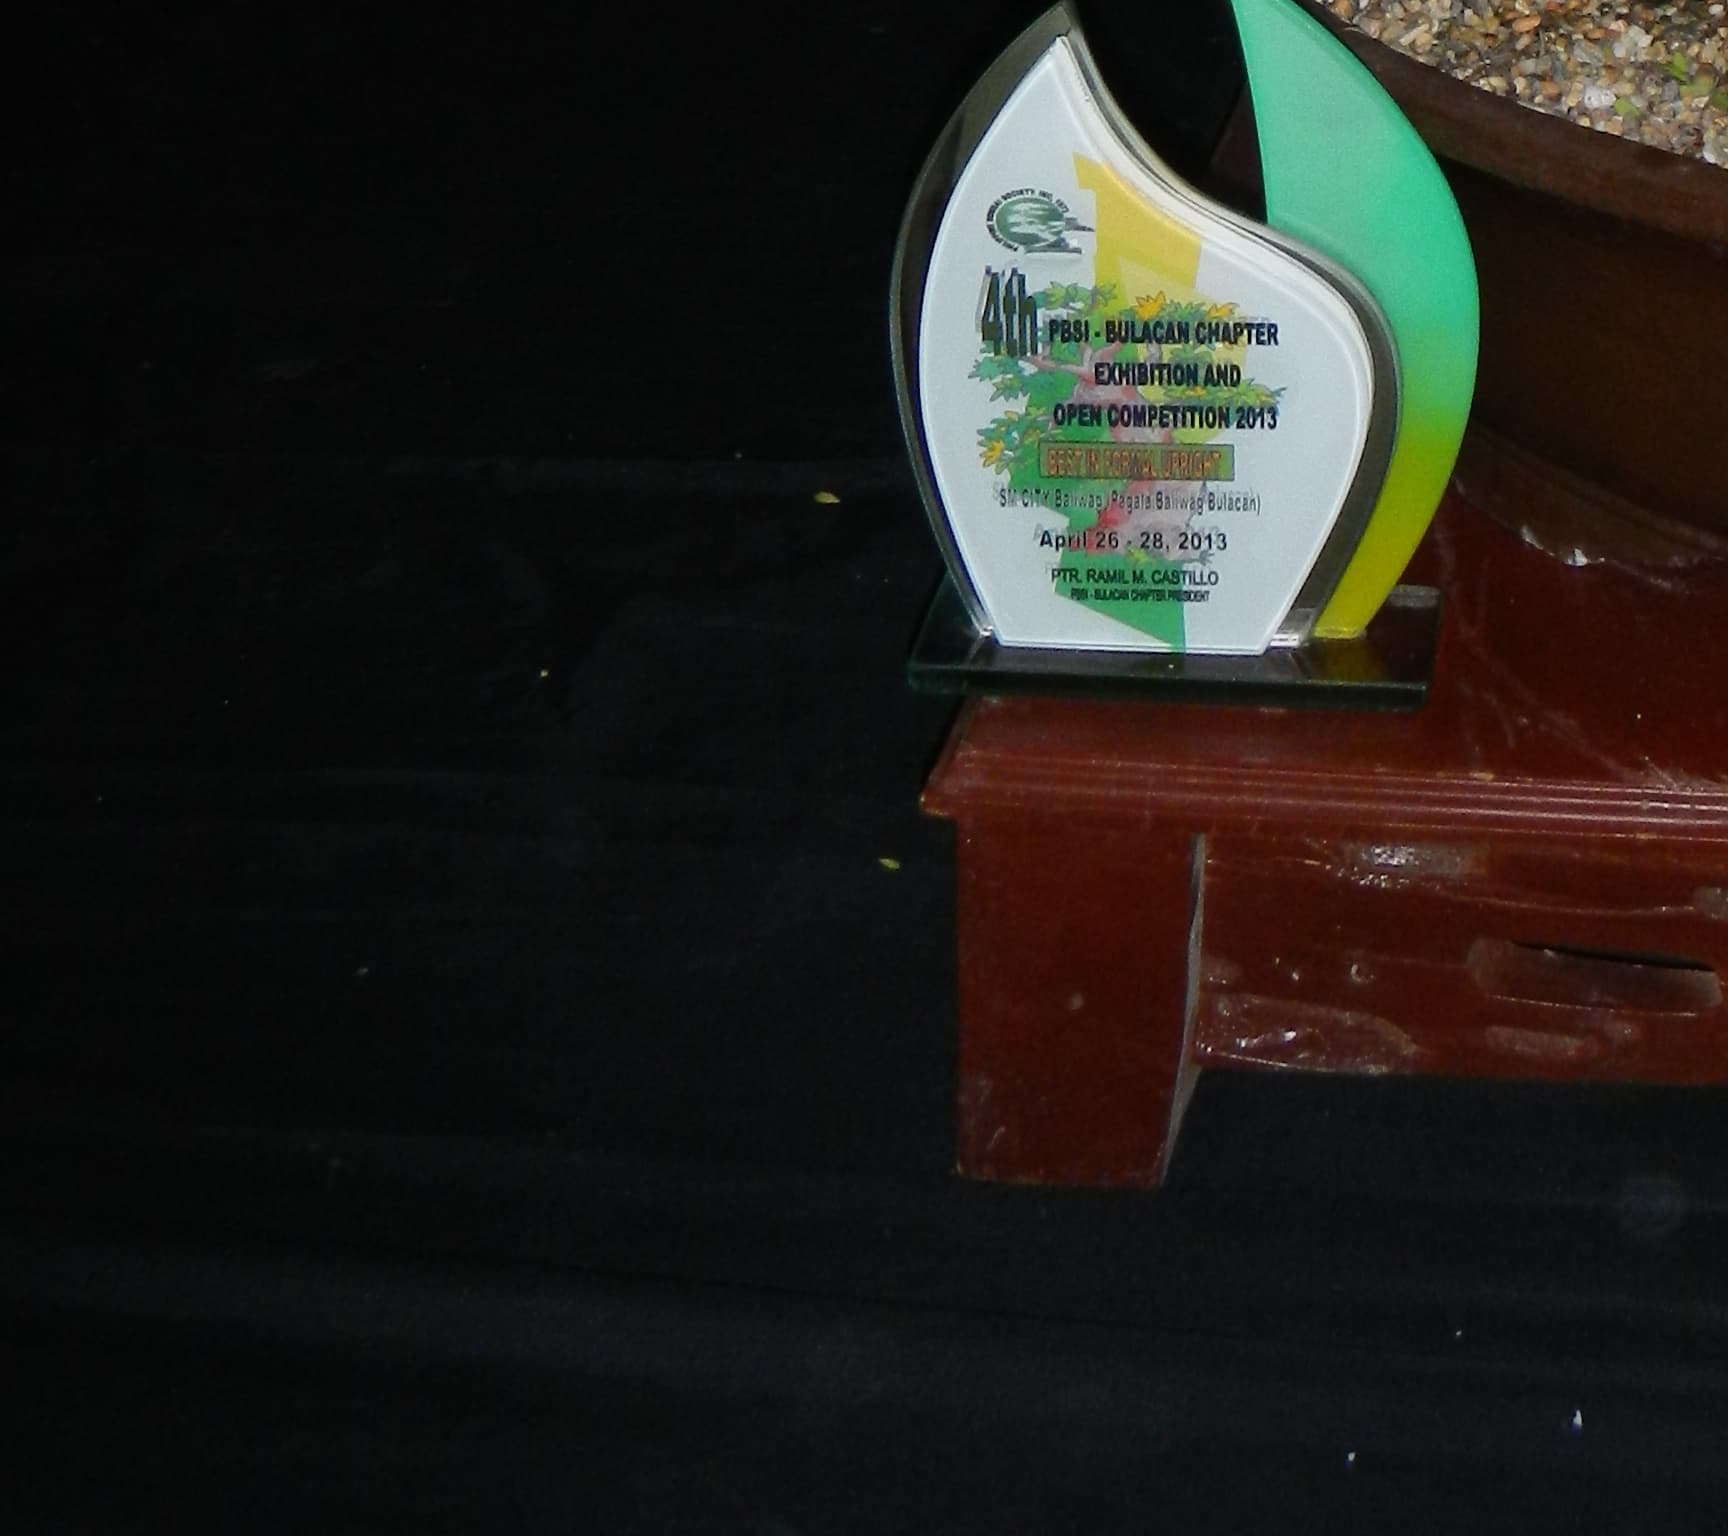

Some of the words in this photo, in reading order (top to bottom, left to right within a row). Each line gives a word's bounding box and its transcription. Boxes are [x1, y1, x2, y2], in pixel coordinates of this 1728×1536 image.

[981, 266, 1038, 356] 4th
[1049, 319, 1089, 344] PBSI
[1105, 320, 1190, 344] BULACAN
[1194, 321, 1279, 346] CHAPTER
[1094, 362, 1199, 387] EXHIBITION
[1204, 363, 1242, 388] AND
[1053, 403, 1101, 427] OPEN
[1107, 404, 1230, 428] COMPETITION
[1235, 405, 1278, 429] 2013
[1046, 448, 1082, 475] BEST
[1085, 449, 1099, 476] IN
[1161, 450, 1222, 478] UPRIGHT
[1208, 491, 1262, 516] Bulacan)
[1040, 530, 1087, 551] April
[1095, 531, 1119, 549] 26
[1140, 531, 1171, 552] 28,
[1178, 532, 1228, 551] 2013
[1087, 568, 1130, 584] RAMIL
[1133, 569, 1148, 584] M.
[1152, 570, 1220, 586] CASTILLO
